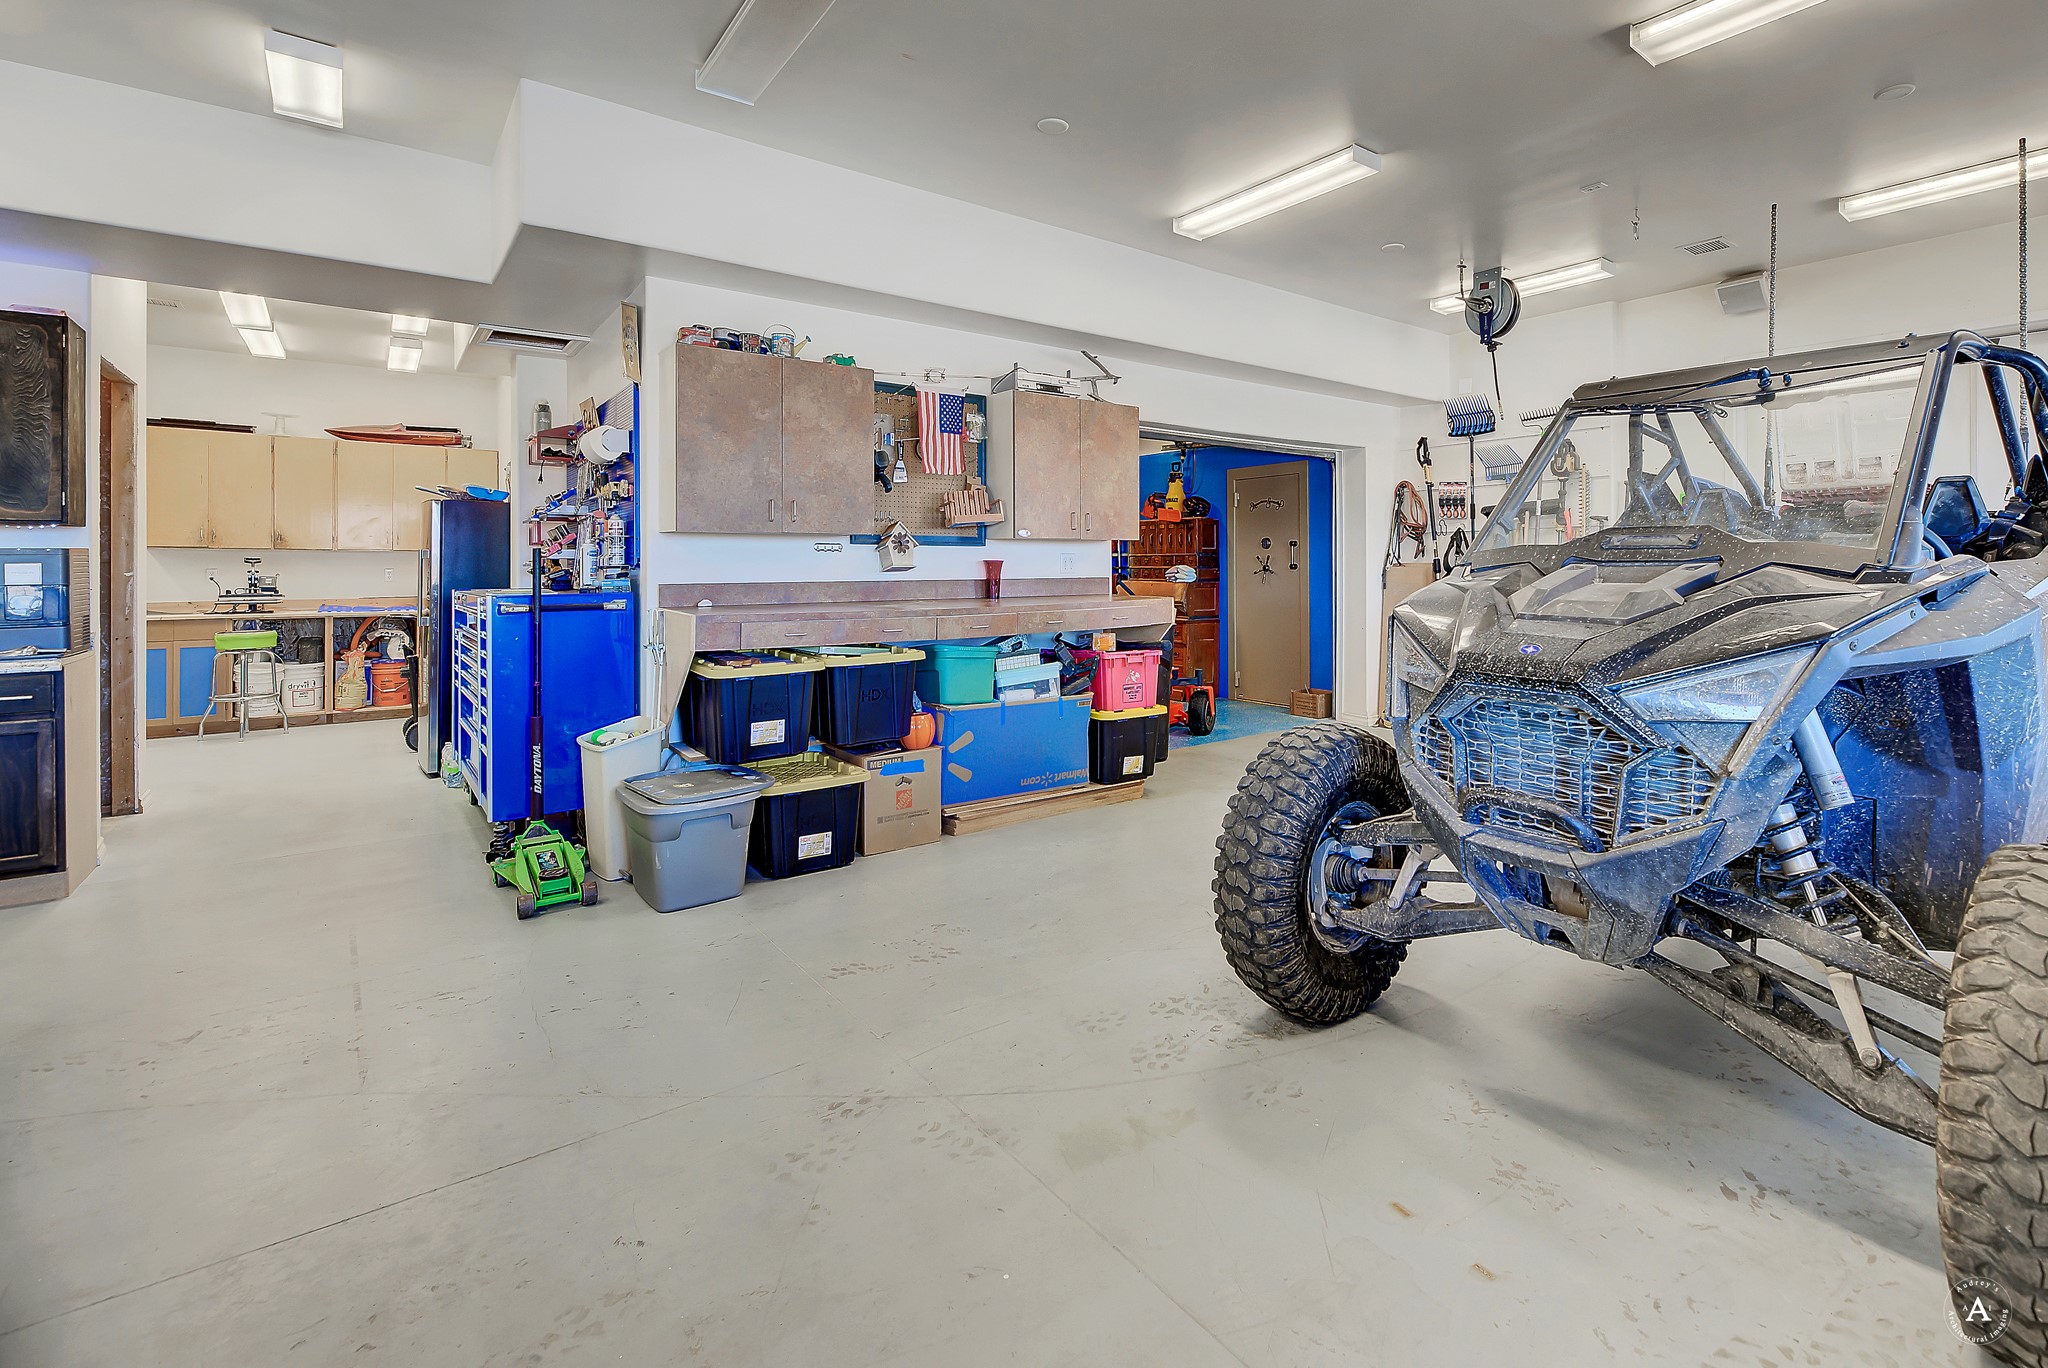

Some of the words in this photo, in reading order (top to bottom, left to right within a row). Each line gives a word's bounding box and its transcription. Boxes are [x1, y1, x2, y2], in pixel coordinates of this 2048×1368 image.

[287, 679, 310, 690] dryvit
[861, 687, 890, 703] HDX
[1054, 768, 1089, 783] Walmart
